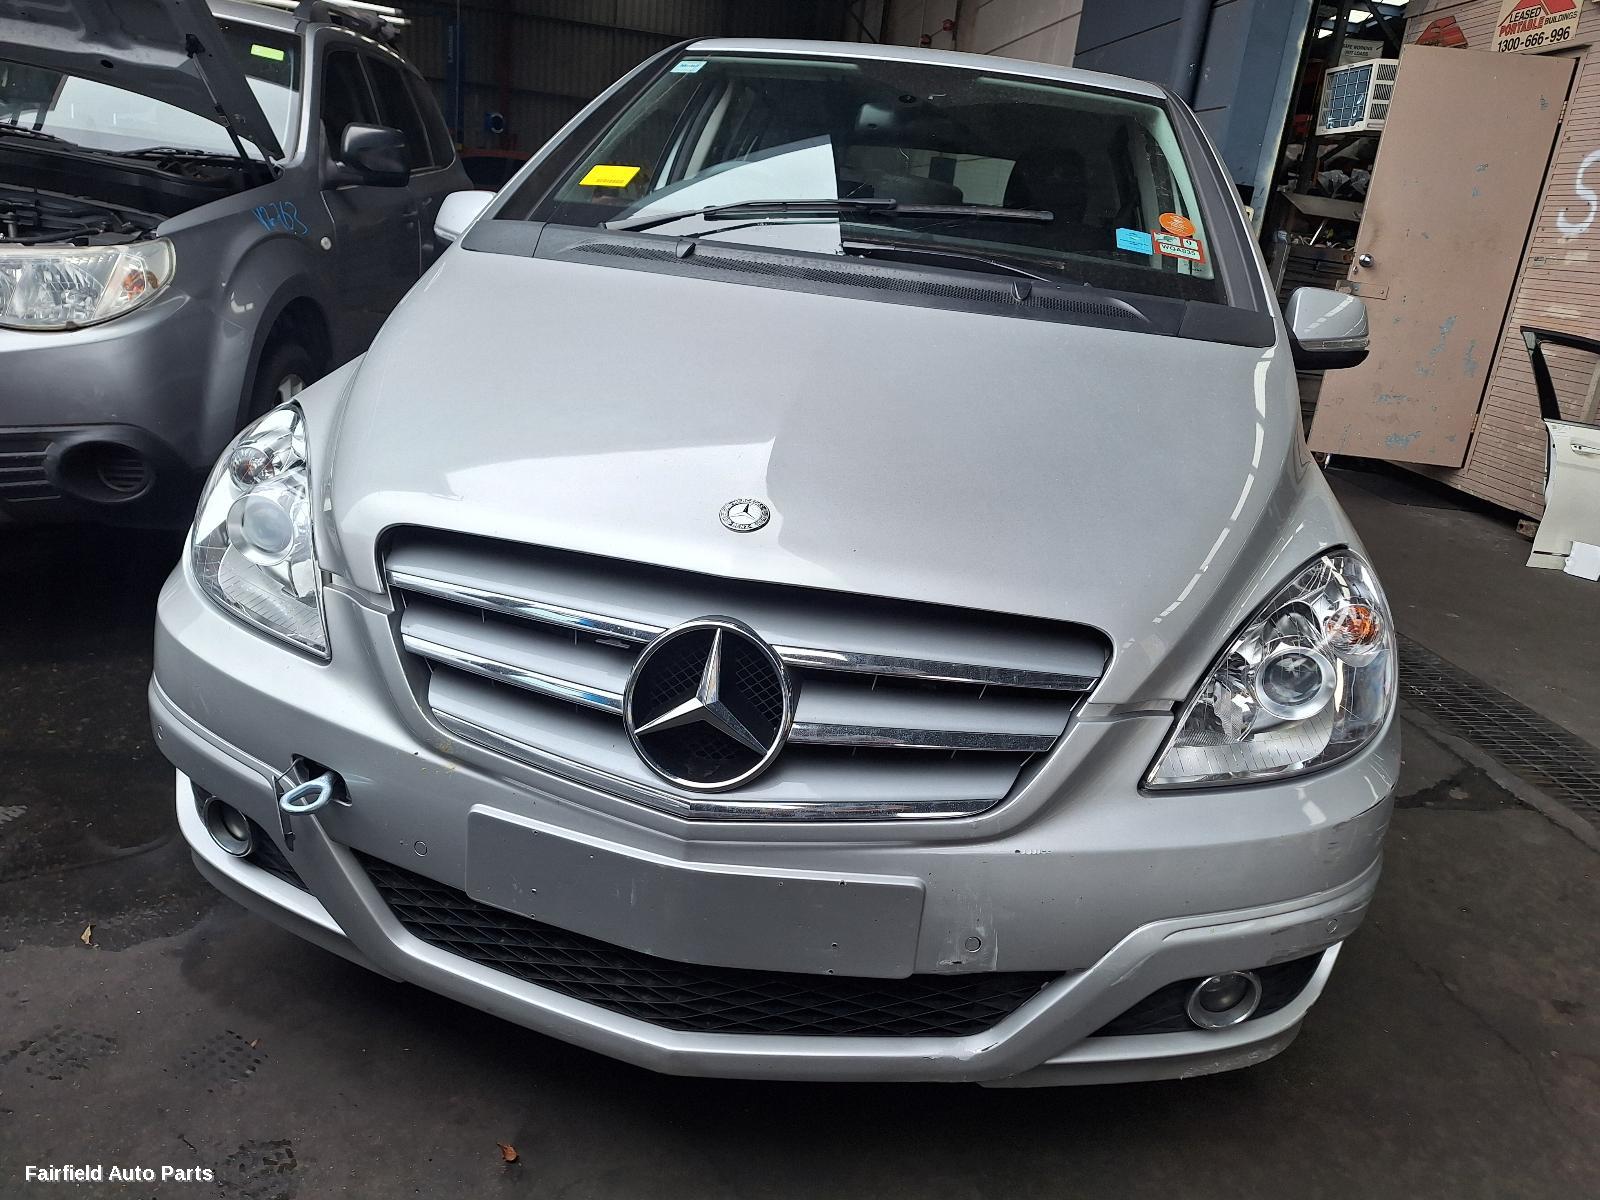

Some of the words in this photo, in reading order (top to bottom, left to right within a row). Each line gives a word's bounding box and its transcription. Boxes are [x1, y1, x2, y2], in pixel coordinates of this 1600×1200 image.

[1499, 16, 1546, 37] PORTABLE
[1544, 11, 1578, 25] BUILDINGS
[1509, 7, 1541, 23] LEASED
[1498, 26, 1570, 52] 1300-666-996
